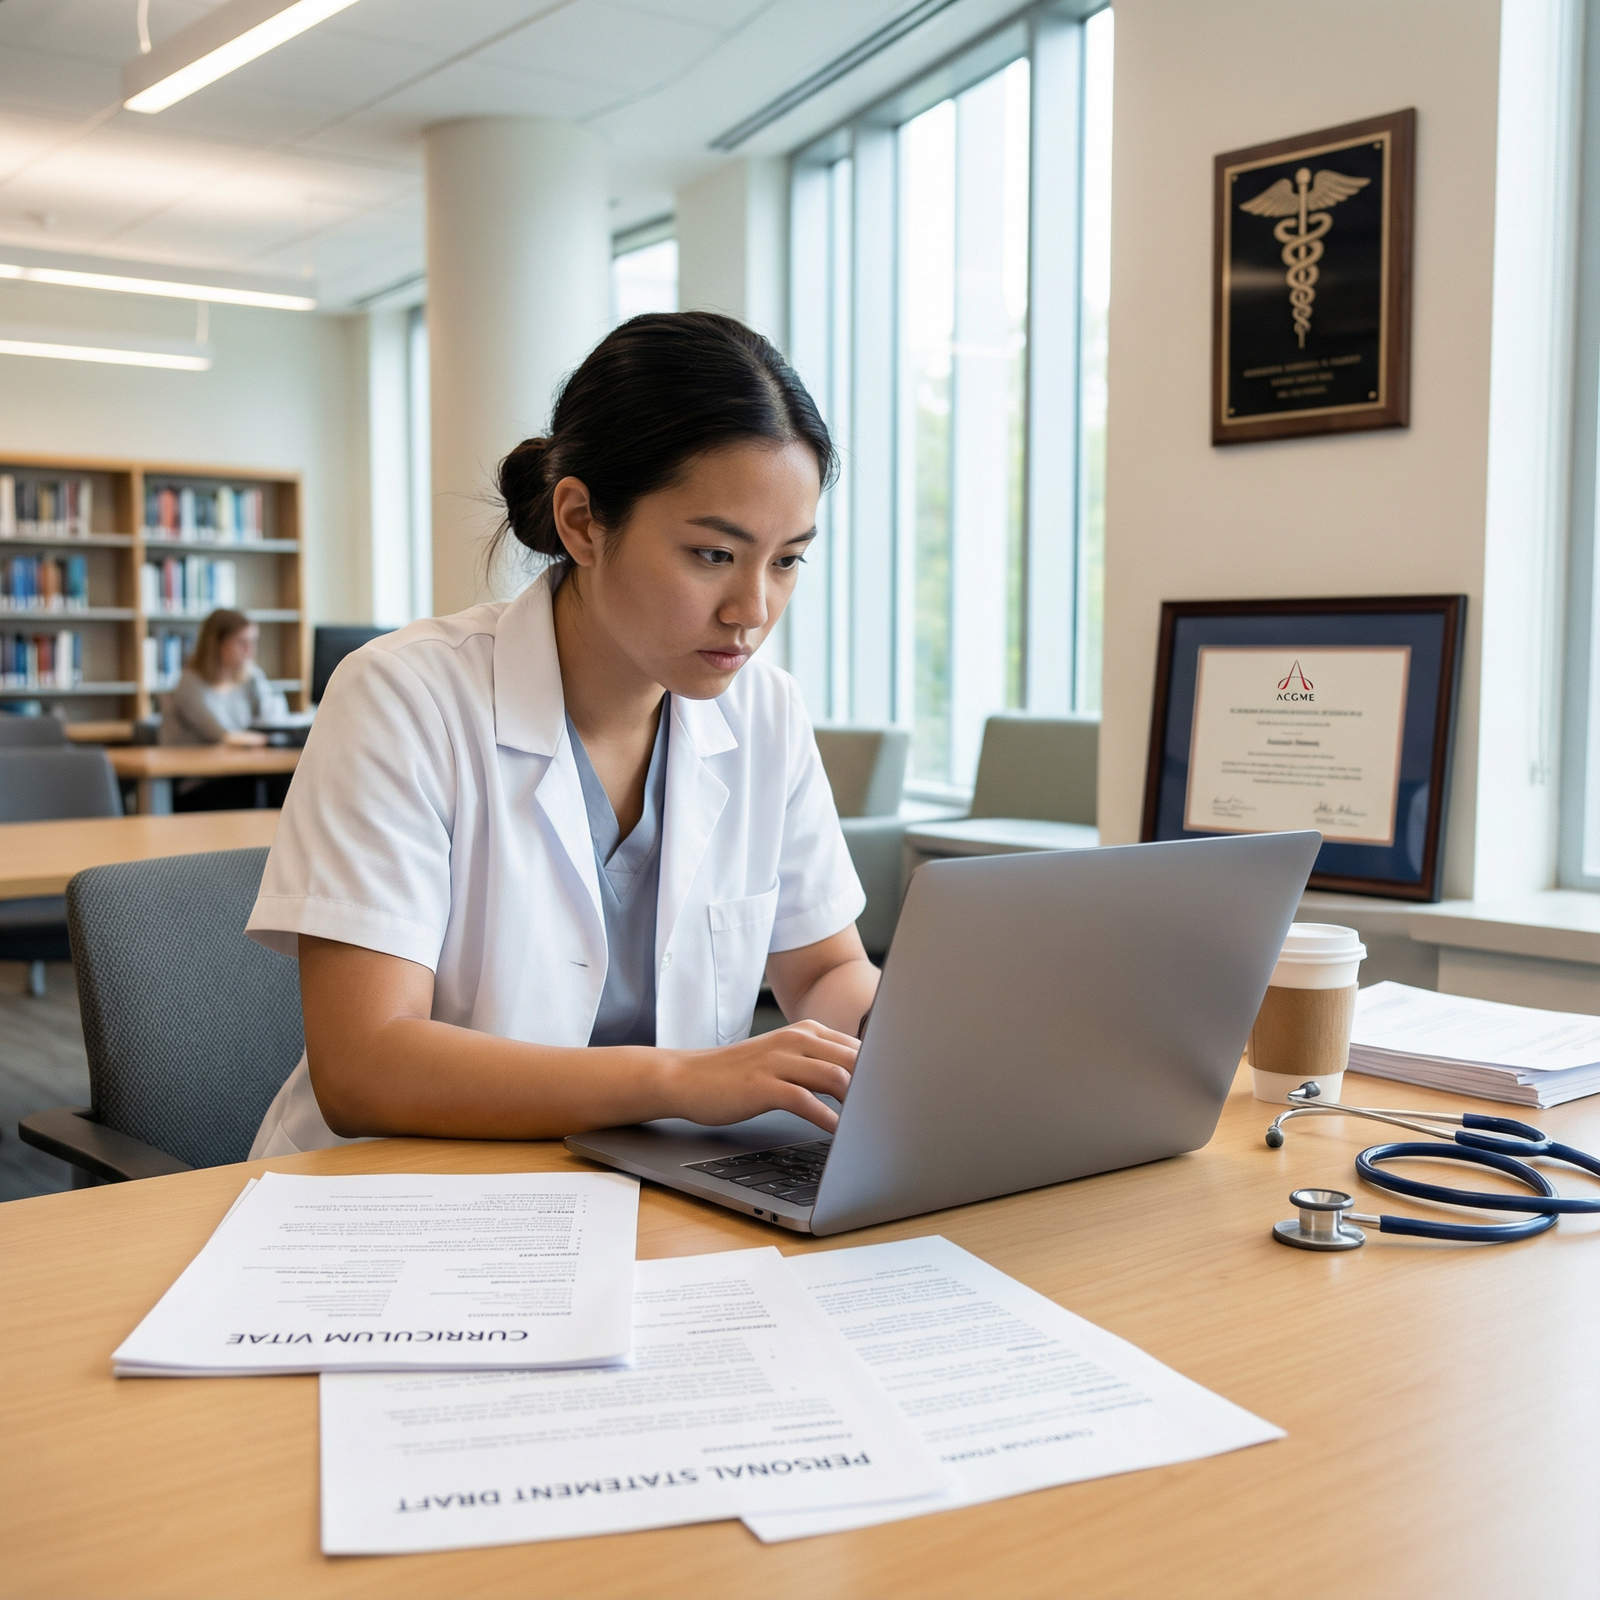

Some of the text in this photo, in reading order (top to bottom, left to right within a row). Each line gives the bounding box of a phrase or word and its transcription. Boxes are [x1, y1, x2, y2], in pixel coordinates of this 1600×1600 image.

[1276, 692, 1315, 702] ACGME
[225, 1329, 530, 1345] CURRICULUM VITAE
[395, 1450, 873, 1514] PERSONAL STATEMENT DRAFT
